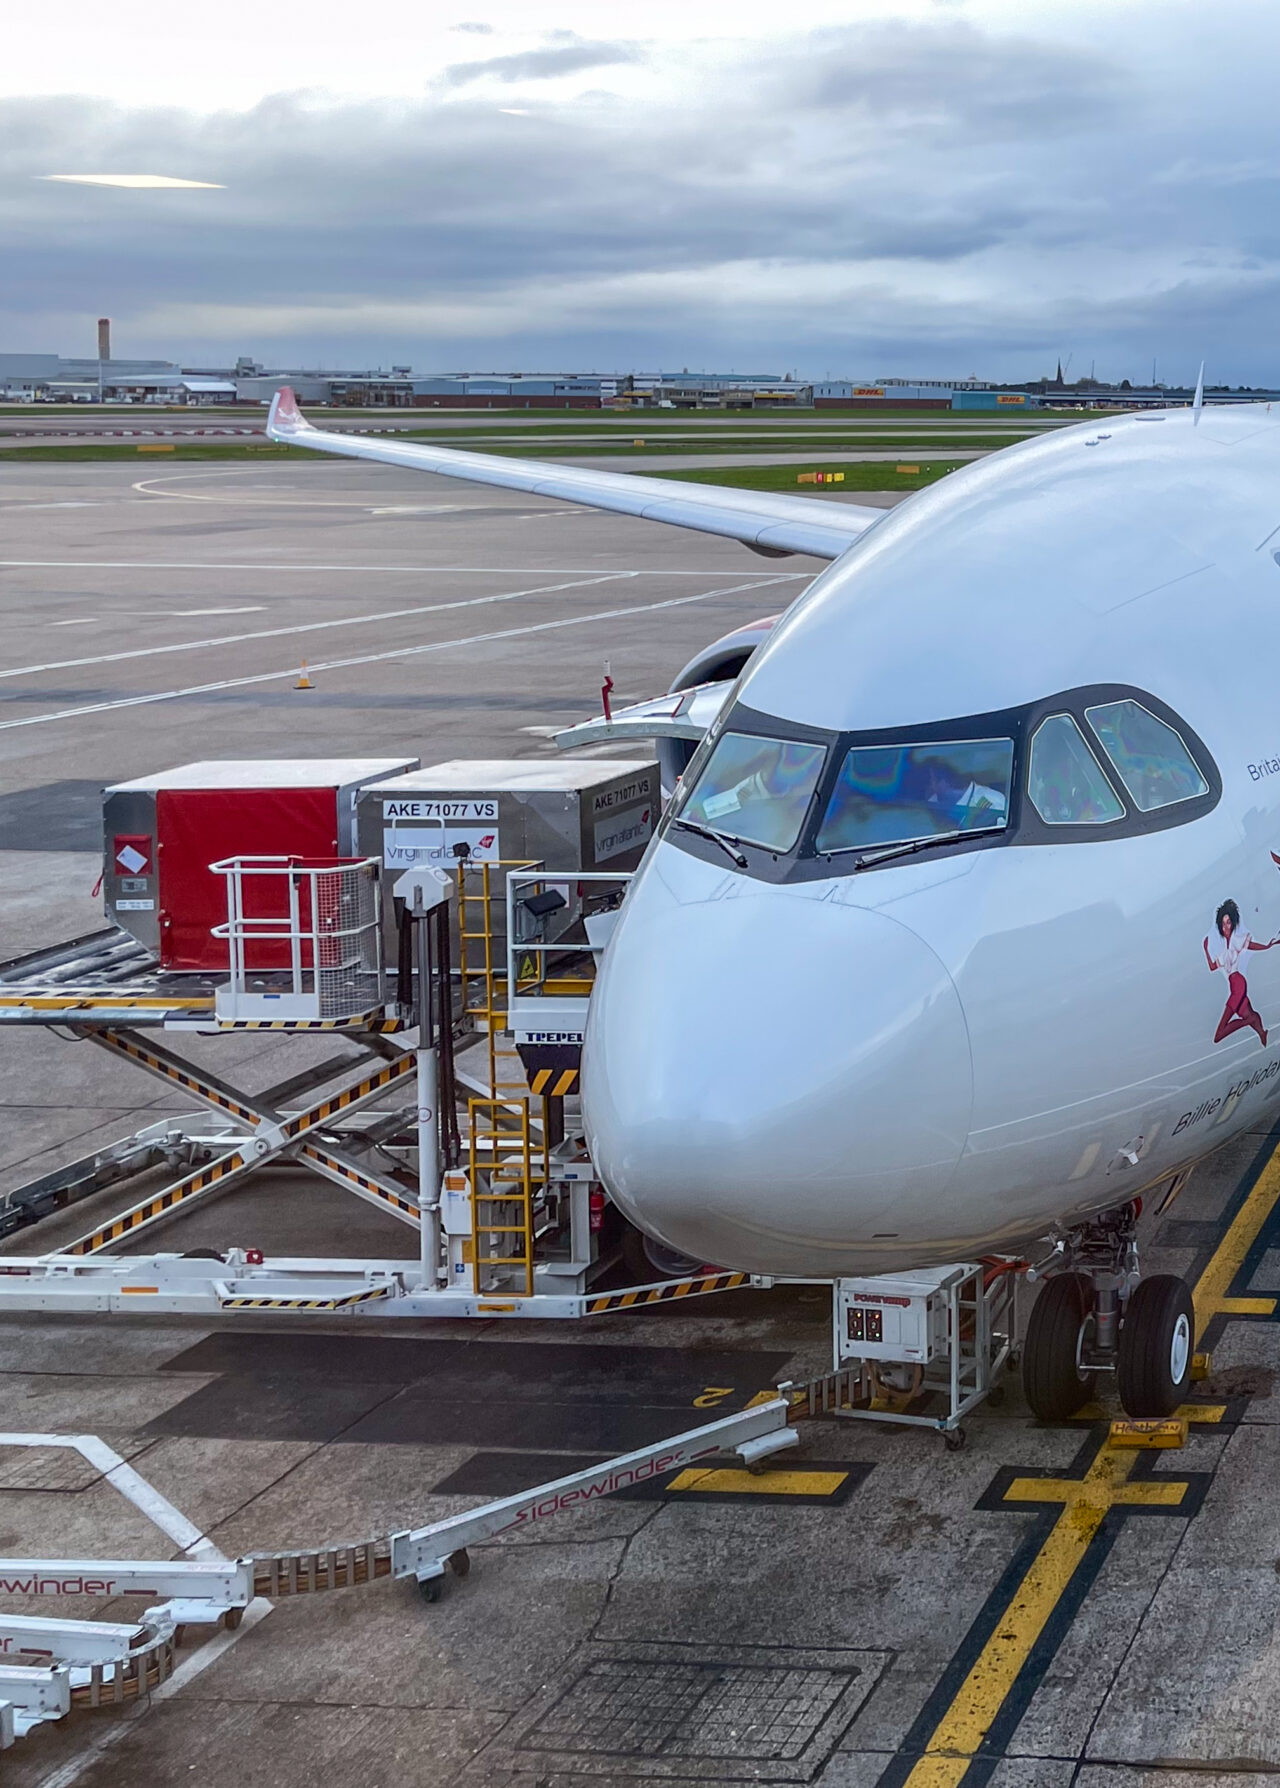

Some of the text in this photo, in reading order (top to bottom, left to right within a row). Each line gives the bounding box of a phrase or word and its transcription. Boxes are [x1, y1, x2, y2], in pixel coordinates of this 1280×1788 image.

[595, 780, 649, 810] AKE 71077 VS
[387, 803, 495, 816] AKE 71077 VS
[1171, 1097, 1222, 1136] Billie
[693, 1387, 735, 1408] 2
